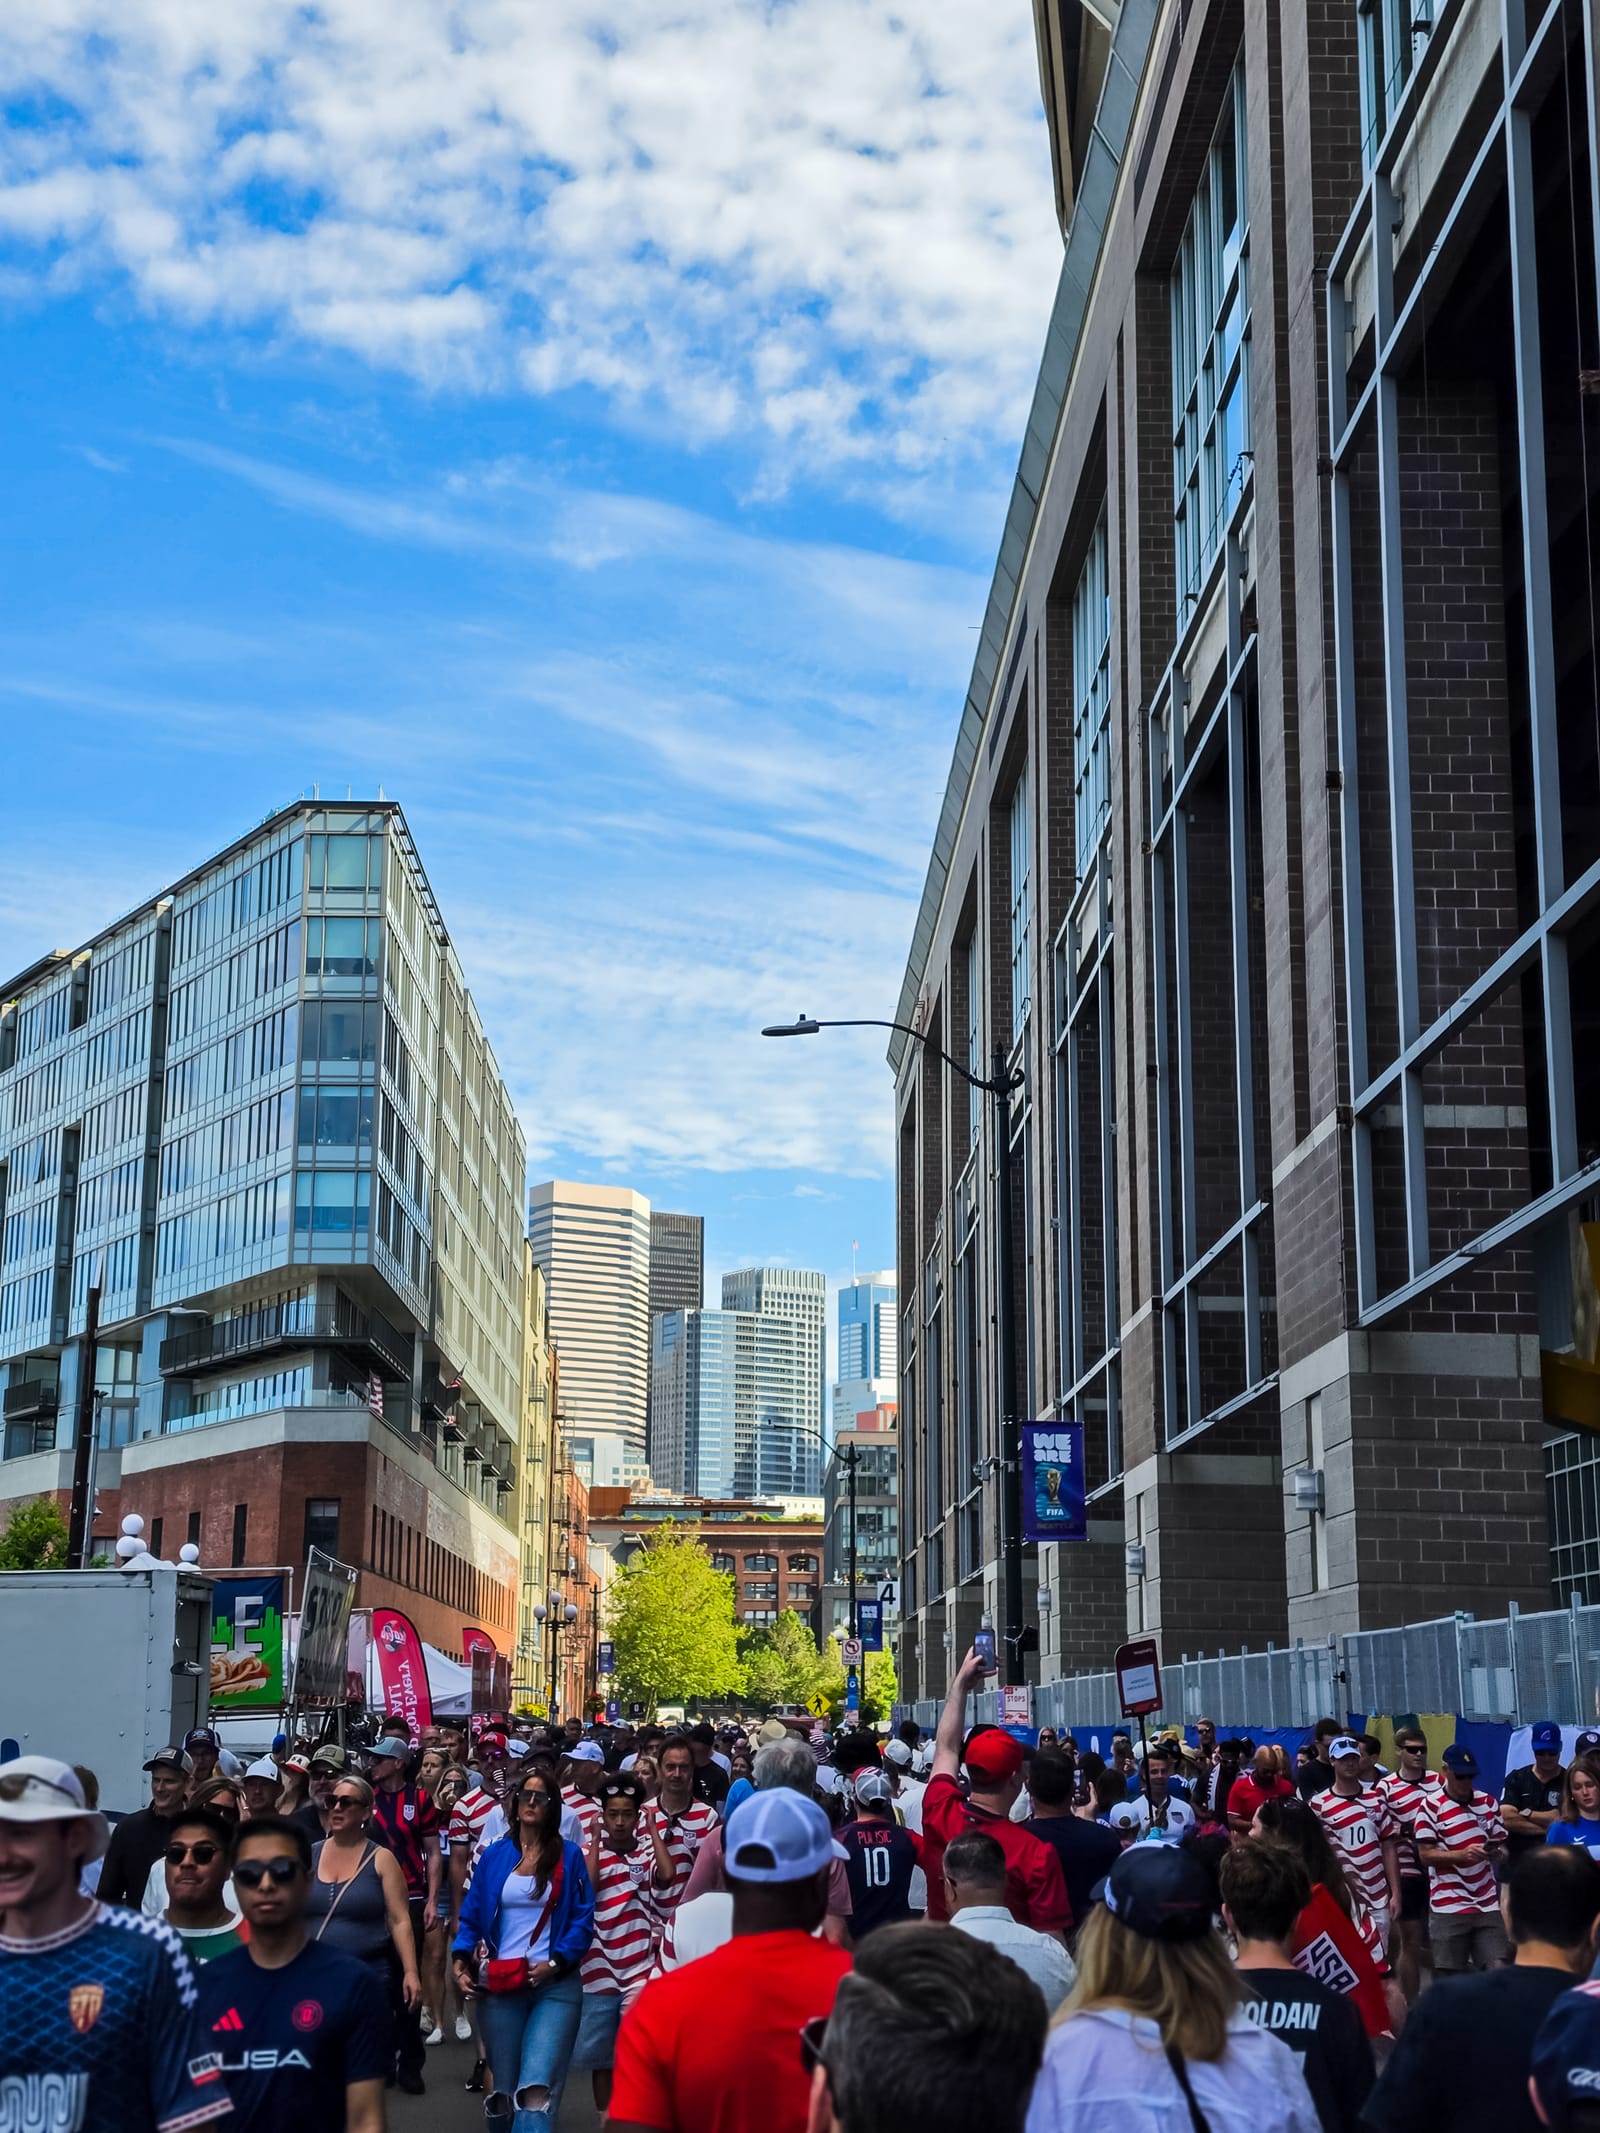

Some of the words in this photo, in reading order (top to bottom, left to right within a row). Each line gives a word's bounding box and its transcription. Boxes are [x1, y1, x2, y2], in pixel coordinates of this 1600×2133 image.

[1033, 1433, 1071, 1449] WE
[880, 1583, 896, 1605] 4
[1350, 1826, 1366, 1846] 10
[863, 1847, 890, 1887] 10
[1310, 1937, 1356, 1993] USA
[219, 2049, 312, 2070] USA
